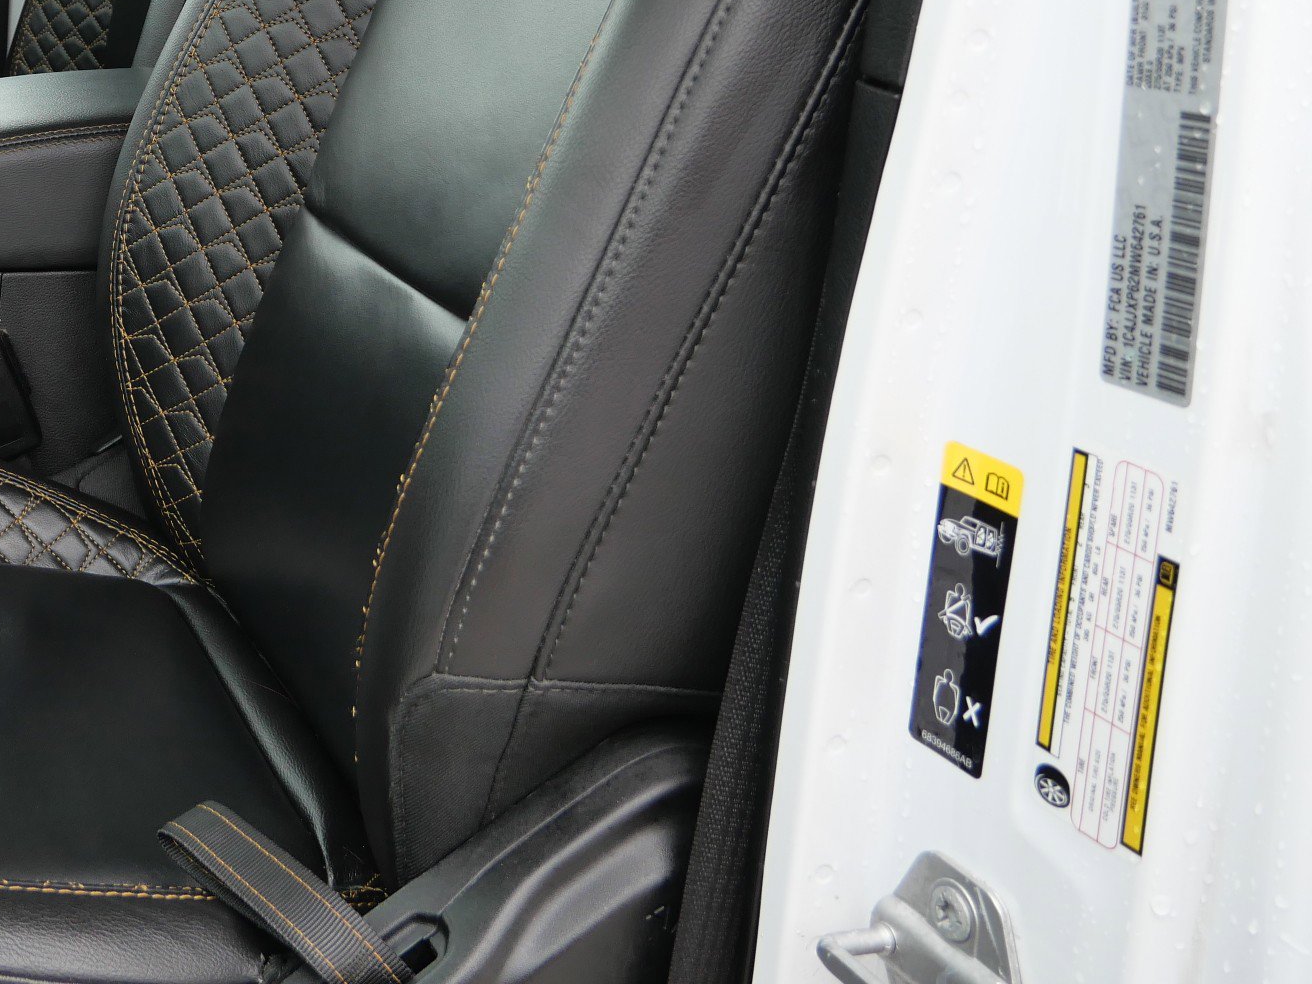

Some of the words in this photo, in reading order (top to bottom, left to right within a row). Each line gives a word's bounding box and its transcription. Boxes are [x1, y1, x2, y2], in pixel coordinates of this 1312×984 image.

[1128, 52, 1136, 61] OF
[1138, 31, 1147, 57] FRONT
[1126, 65, 1135, 86] DATE
[1113, 234, 1126, 258] LLC
[1148, 214, 1163, 257] U.S.A.
[1111, 263, 1124, 282] US
[1146, 262, 1159, 281] IN:
[1109, 286, 1122, 313] FCA
[1142, 285, 1157, 327] MADE
[1106, 318, 1120, 342] BY:
[1104, 346, 1117, 377] MFD
[1120, 353, 1134, 382] VIN:
[1137, 331, 1154, 388] VEHICLE
[1095, 459, 1104, 486] EXCEED
[1091, 488, 1100, 512] NEVER
[1058, 527, 1072, 585] INFORMATION
[1084, 544, 1093, 568] CARGO
[1081, 571, 1089, 585] AND
[1101, 577, 1109, 596] REAR
[1053, 587, 1064, 624] LOADING
[1075, 587, 1087, 629] OCCUPANTS
[1050, 626, 1059, 644] AND
[1074, 632, 1081, 641] OF
[1047, 646, 1056, 665] TIRE
[1070, 643, 1080, 670] WEIGHT
[1065, 671, 1076, 709] COMBINED
